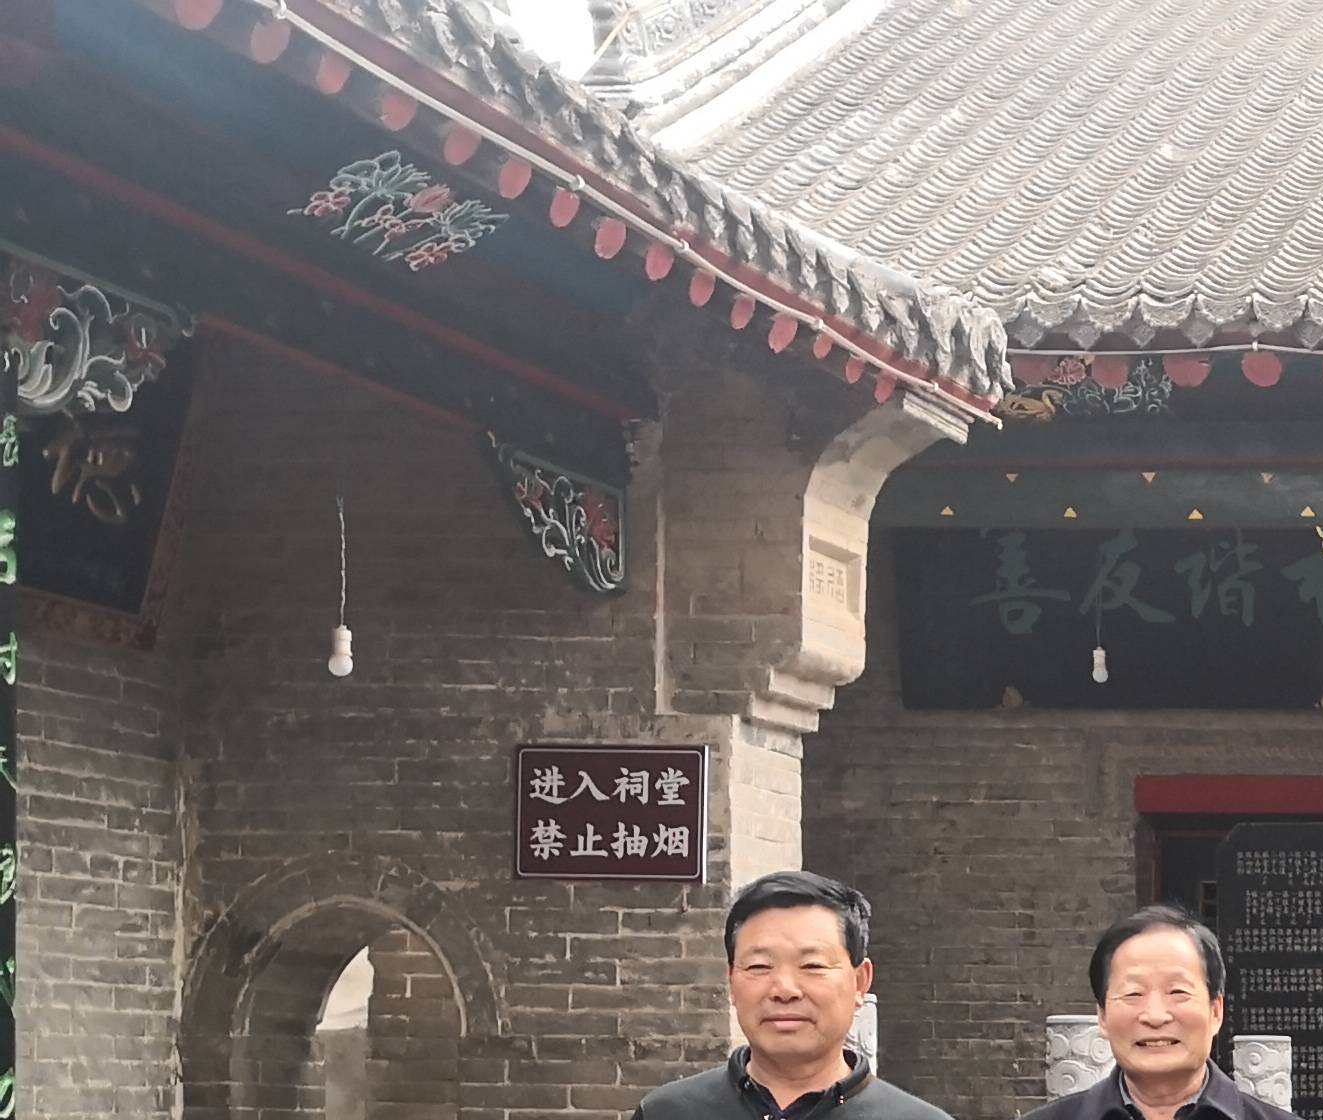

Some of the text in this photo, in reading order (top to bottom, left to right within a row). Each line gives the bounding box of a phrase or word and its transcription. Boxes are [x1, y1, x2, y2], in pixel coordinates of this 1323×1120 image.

[528, 765, 689, 807] 进入祠堂
[528, 821, 691, 861] 禁止抽烟
